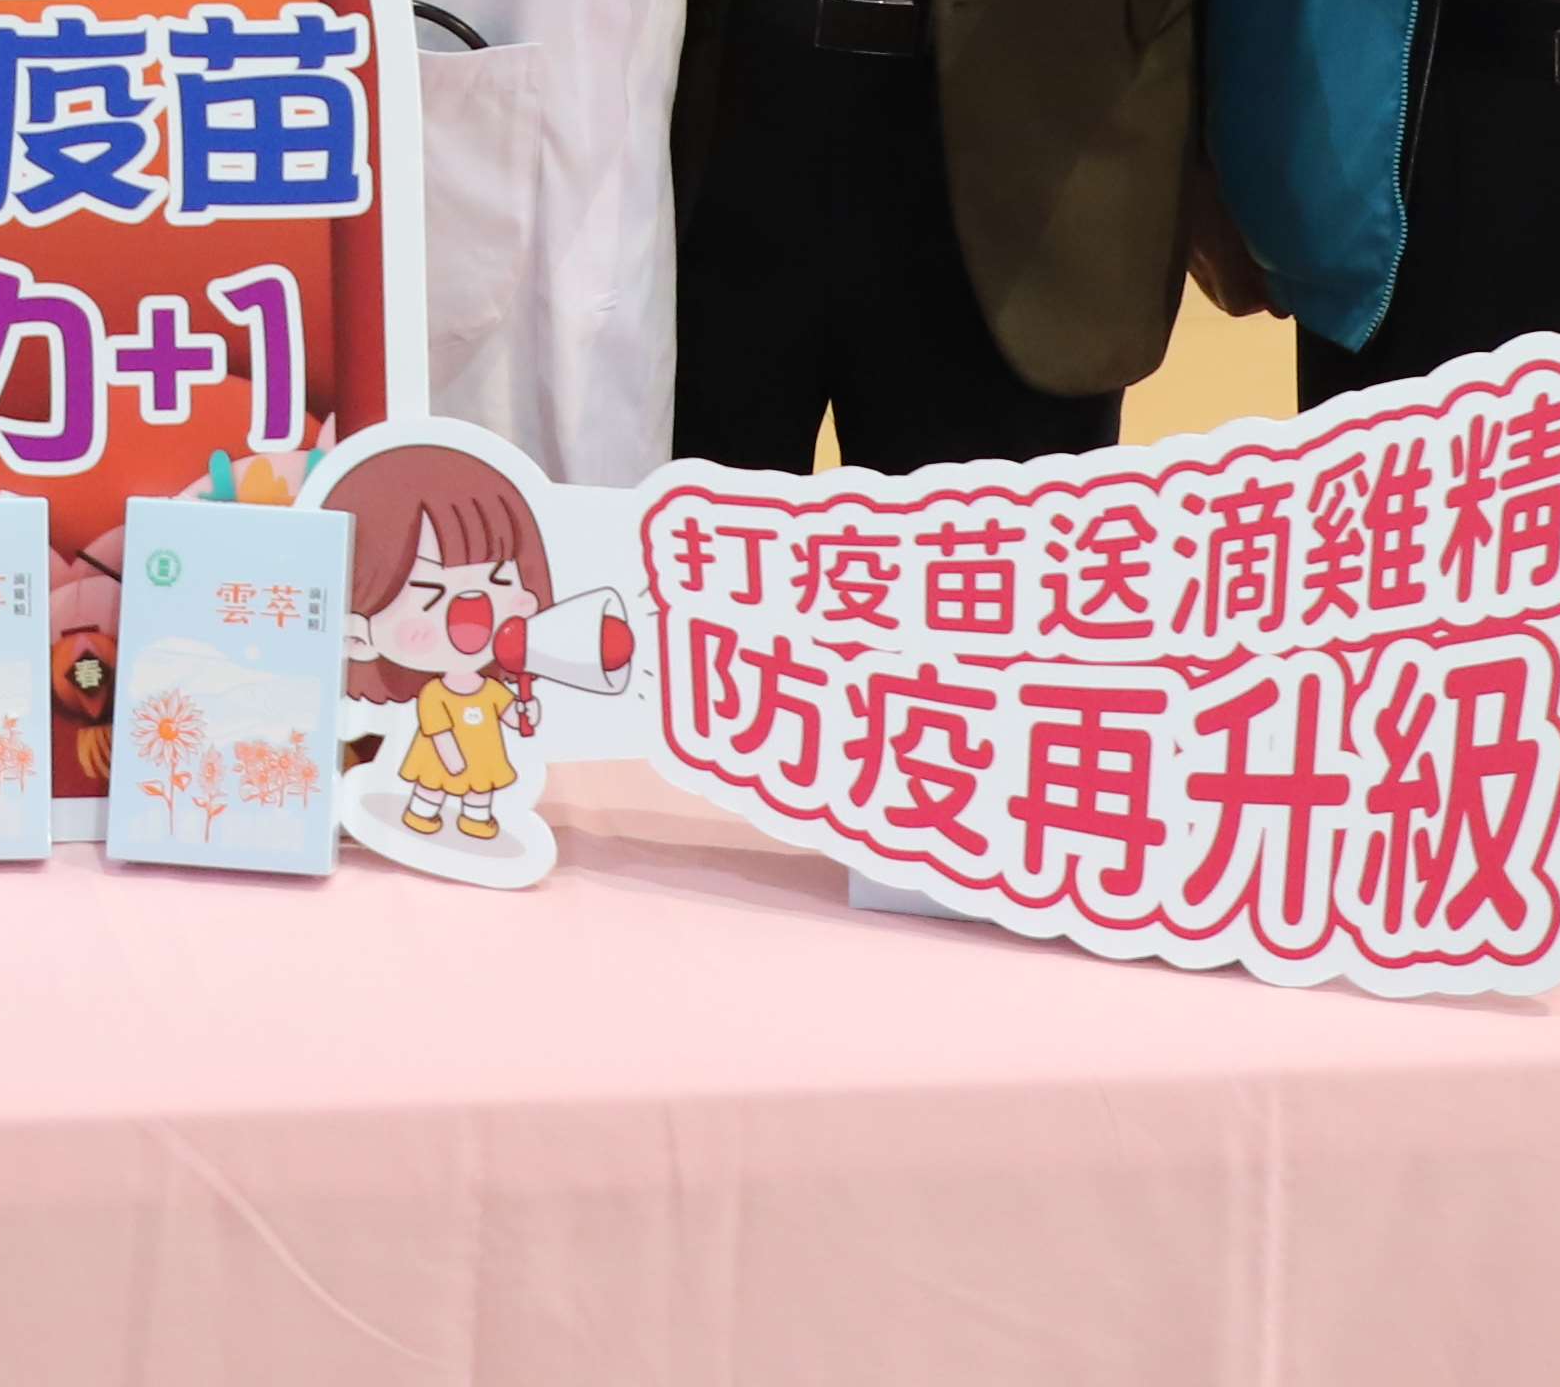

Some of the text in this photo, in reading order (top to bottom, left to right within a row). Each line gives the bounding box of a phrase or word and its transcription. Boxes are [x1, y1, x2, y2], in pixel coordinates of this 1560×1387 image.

[216, 582, 303, 628] 雲萃
[685, 615, 1538, 935] 防疫再升級
